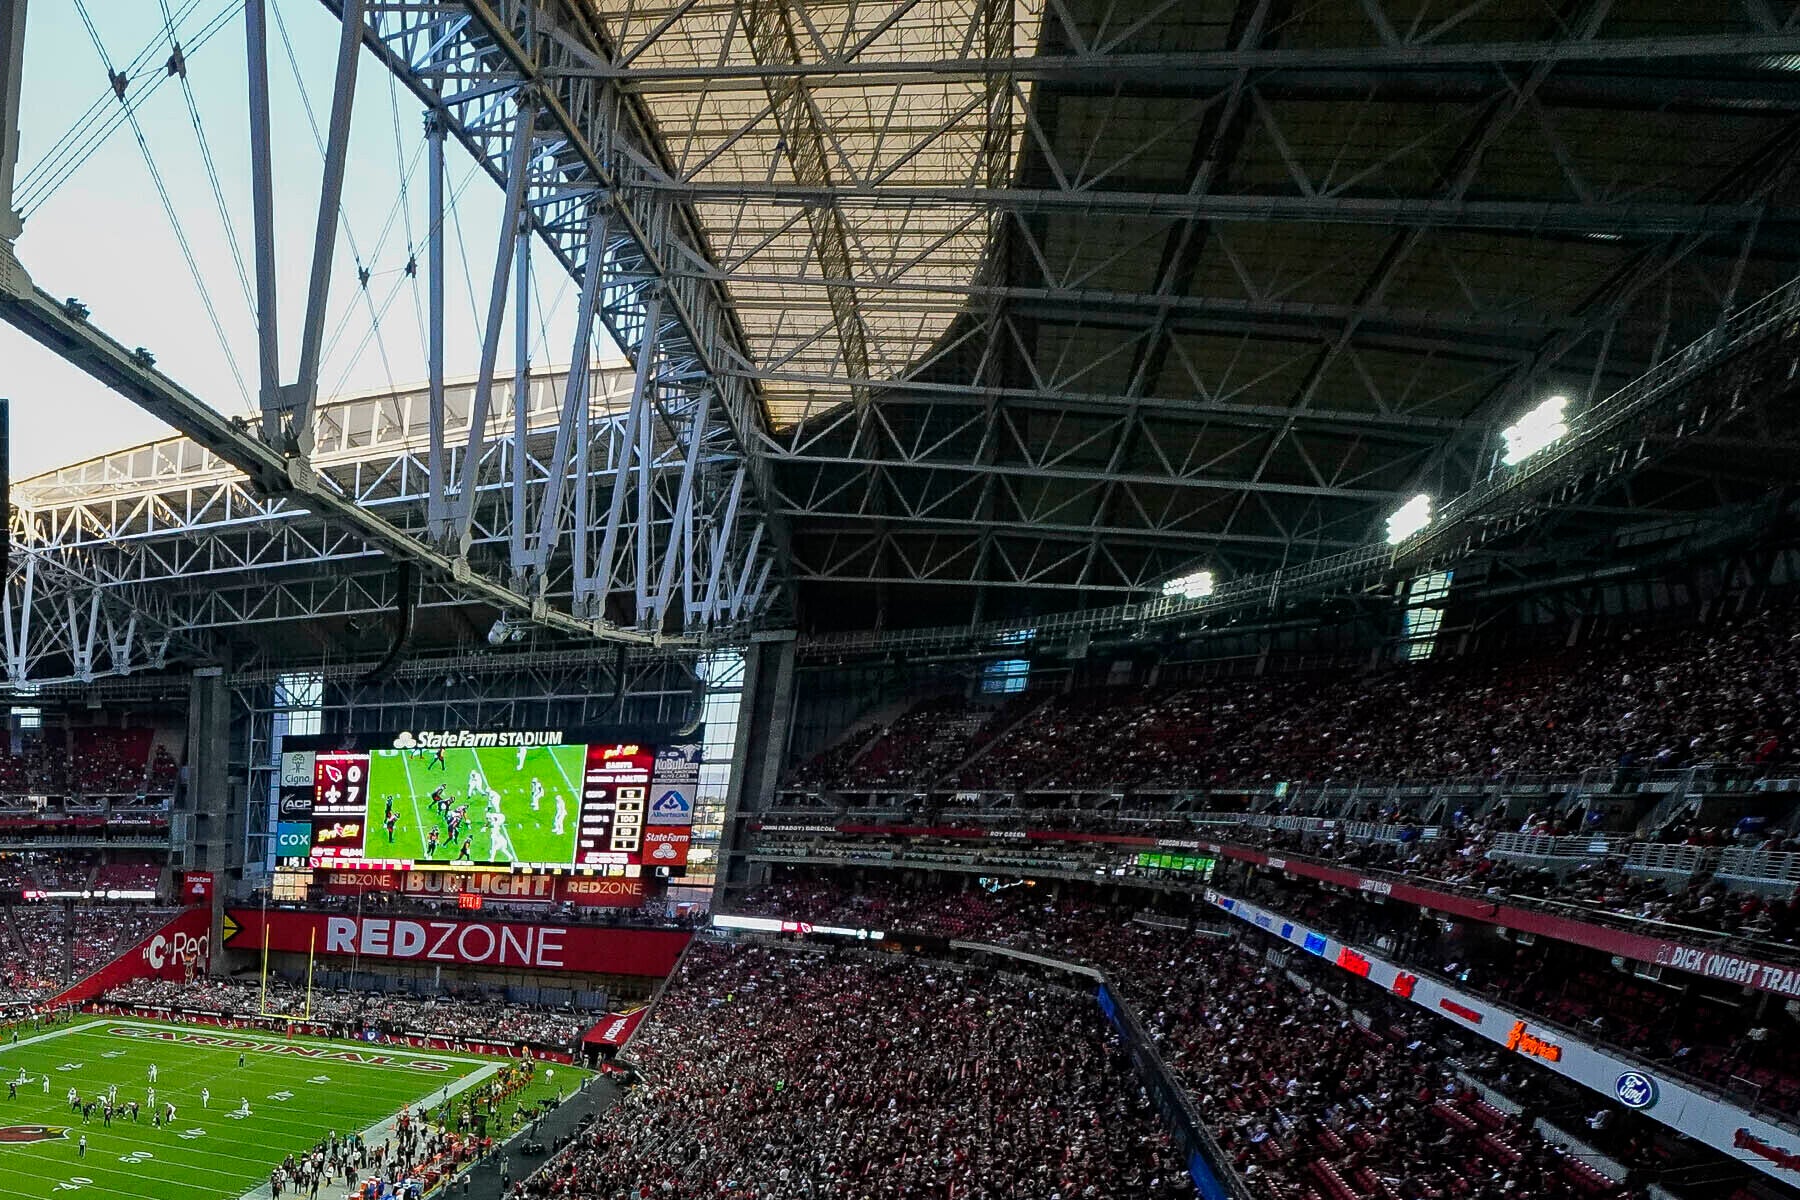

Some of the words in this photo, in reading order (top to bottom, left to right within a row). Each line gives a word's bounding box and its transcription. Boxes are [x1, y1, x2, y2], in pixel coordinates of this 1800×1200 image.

[498, 731, 563, 746] STADIUM
[285, 774, 310, 784] Cigna
[347, 765, 362, 782] 0
[347, 786, 360, 802] 7
[285, 799, 312, 808] ACP
[279, 834, 309, 845] COX
[329, 872, 391, 887] REDZONE
[406, 872, 462, 893] BUD
[465, 873, 550, 897] LIGHT
[567, 881, 643, 896] REDZONE
[171, 927, 210, 966] Red
[326, 916, 567, 968] REDZONE
[1670, 946, 1706, 971] DICK
[1704, 954, 1761, 984] (NIGHT
[107, 1027, 454, 1071] CARDINALS
[1619, 1074, 1649, 1105] Ford
[119, 1144, 154, 1159] 50
[59, 1177, 94, 1191] 40
